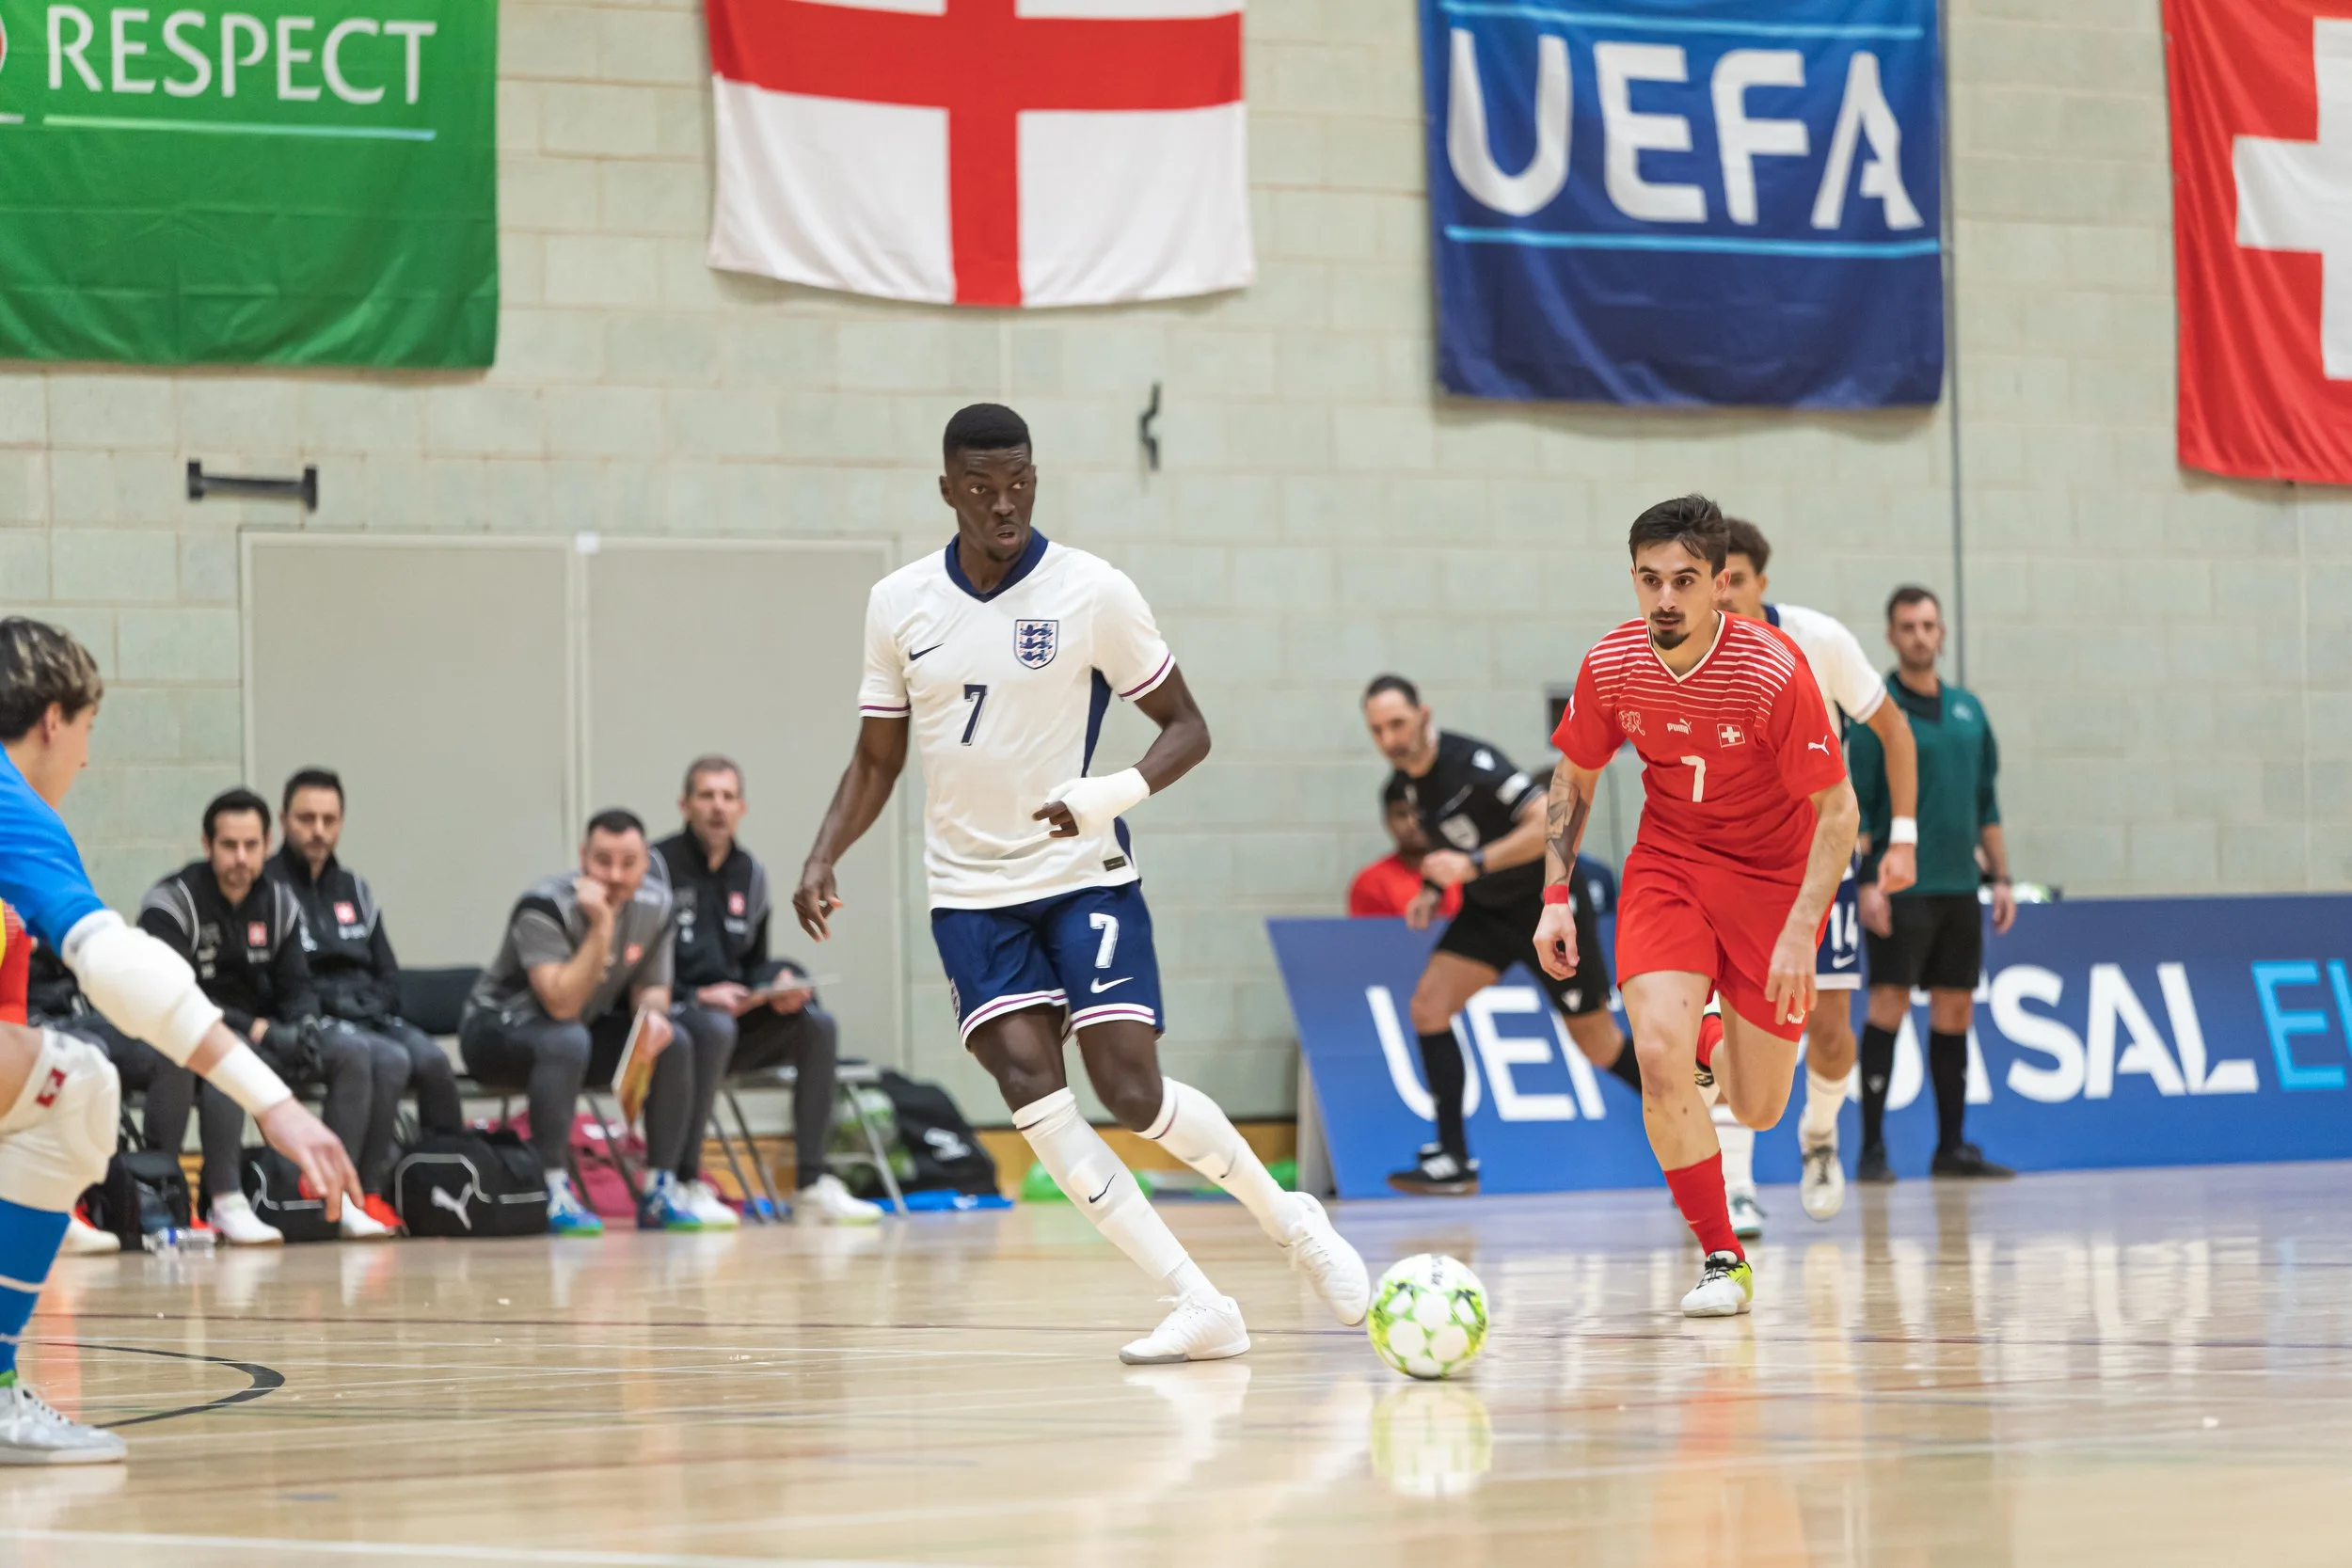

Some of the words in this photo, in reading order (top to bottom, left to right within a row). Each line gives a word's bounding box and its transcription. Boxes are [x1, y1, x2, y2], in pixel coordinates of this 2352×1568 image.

[46, 4, 438, 105] RESPECT
[1445, 27, 1925, 230] UEFA
[961, 683, 989, 746] 7
[1679, 754, 1707, 803] 7
[1089, 912, 1120, 969] 7
